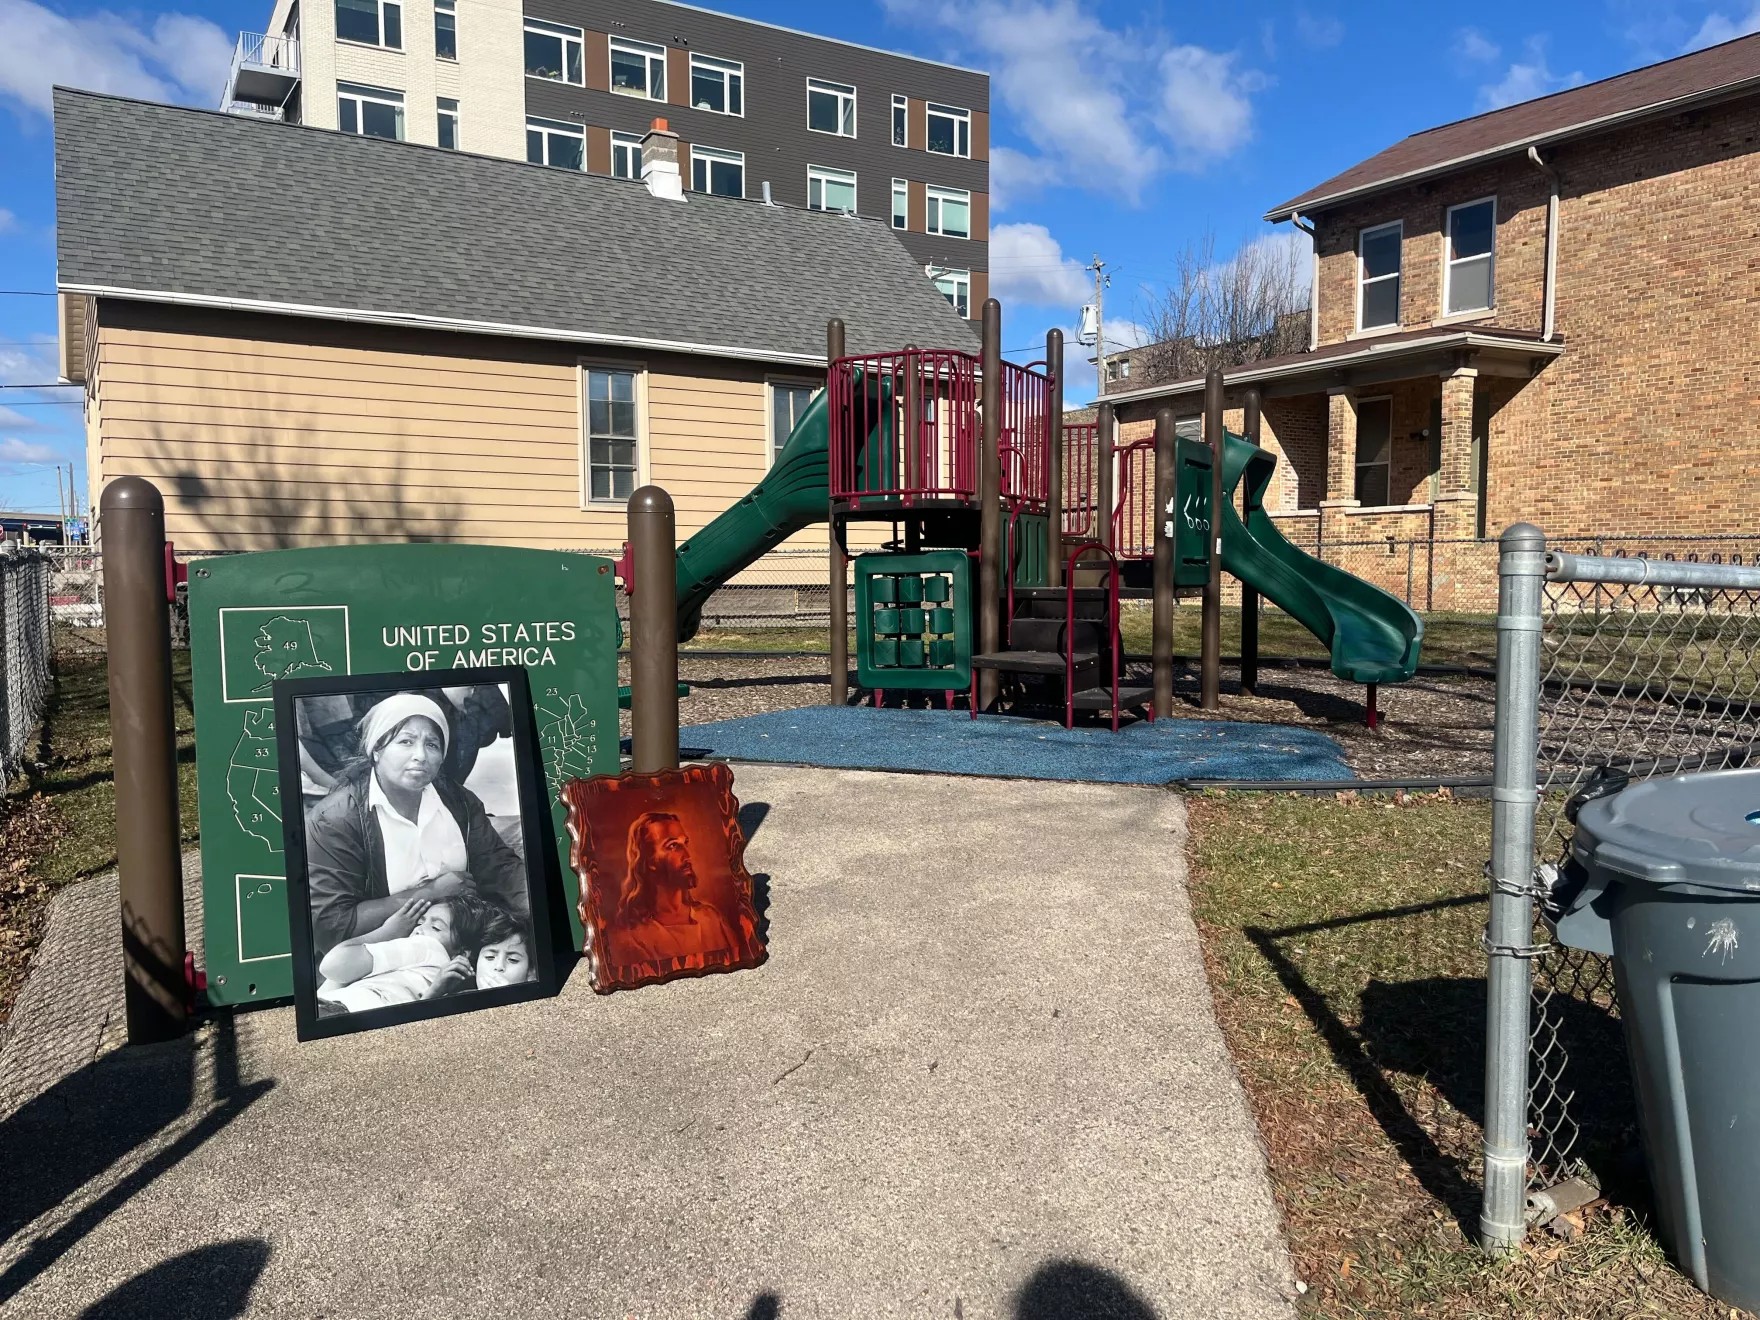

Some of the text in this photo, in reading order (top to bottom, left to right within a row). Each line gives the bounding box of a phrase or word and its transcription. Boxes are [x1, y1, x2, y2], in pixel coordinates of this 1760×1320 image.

[382, 622, 576, 647] UNITED STATES
[283, 641, 298, 650] 49
[406, 646, 557, 671] OF AMERICA
[545, 687, 558, 696] 23
[590, 719, 596, 727] 9
[589, 734, 596, 742] 6
[255, 748, 269, 757] 33
[586, 745, 597, 753] 13
[586, 756, 593, 764] 5
[584, 767, 591, 775] 3
[251, 813, 263, 822] 31
